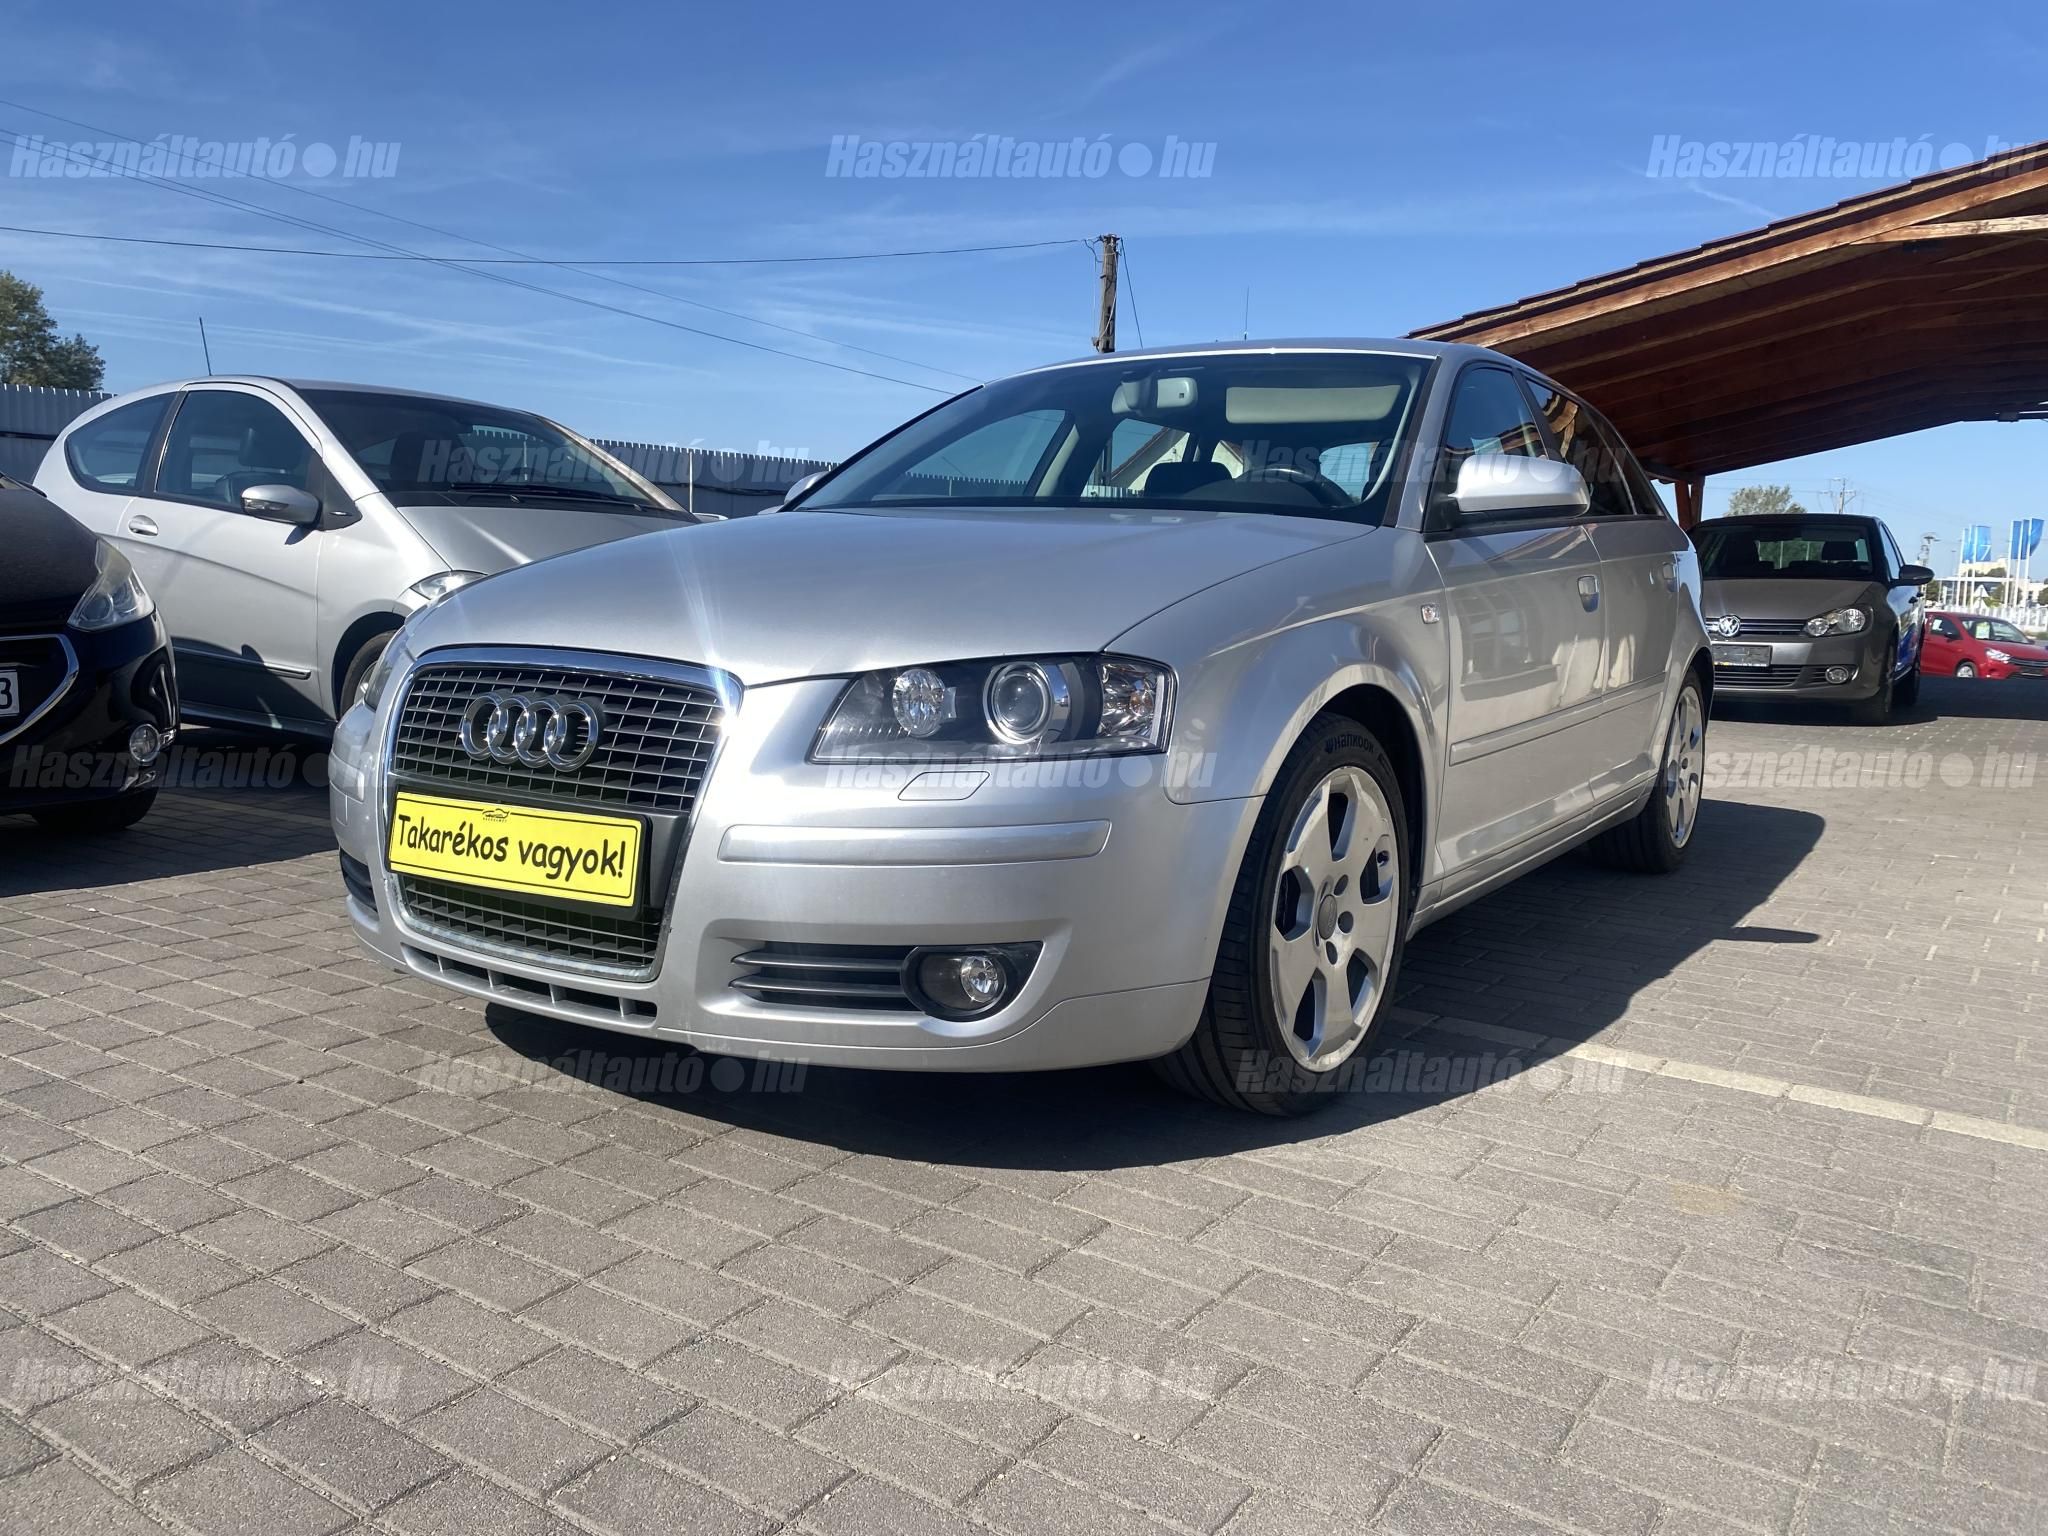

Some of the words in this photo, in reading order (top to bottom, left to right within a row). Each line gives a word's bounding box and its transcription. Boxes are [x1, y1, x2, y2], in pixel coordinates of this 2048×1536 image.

[0, 677, 12, 709] 3
[398, 815, 509, 862] Takarékos
[518, 838, 626, 882] vagyok!
